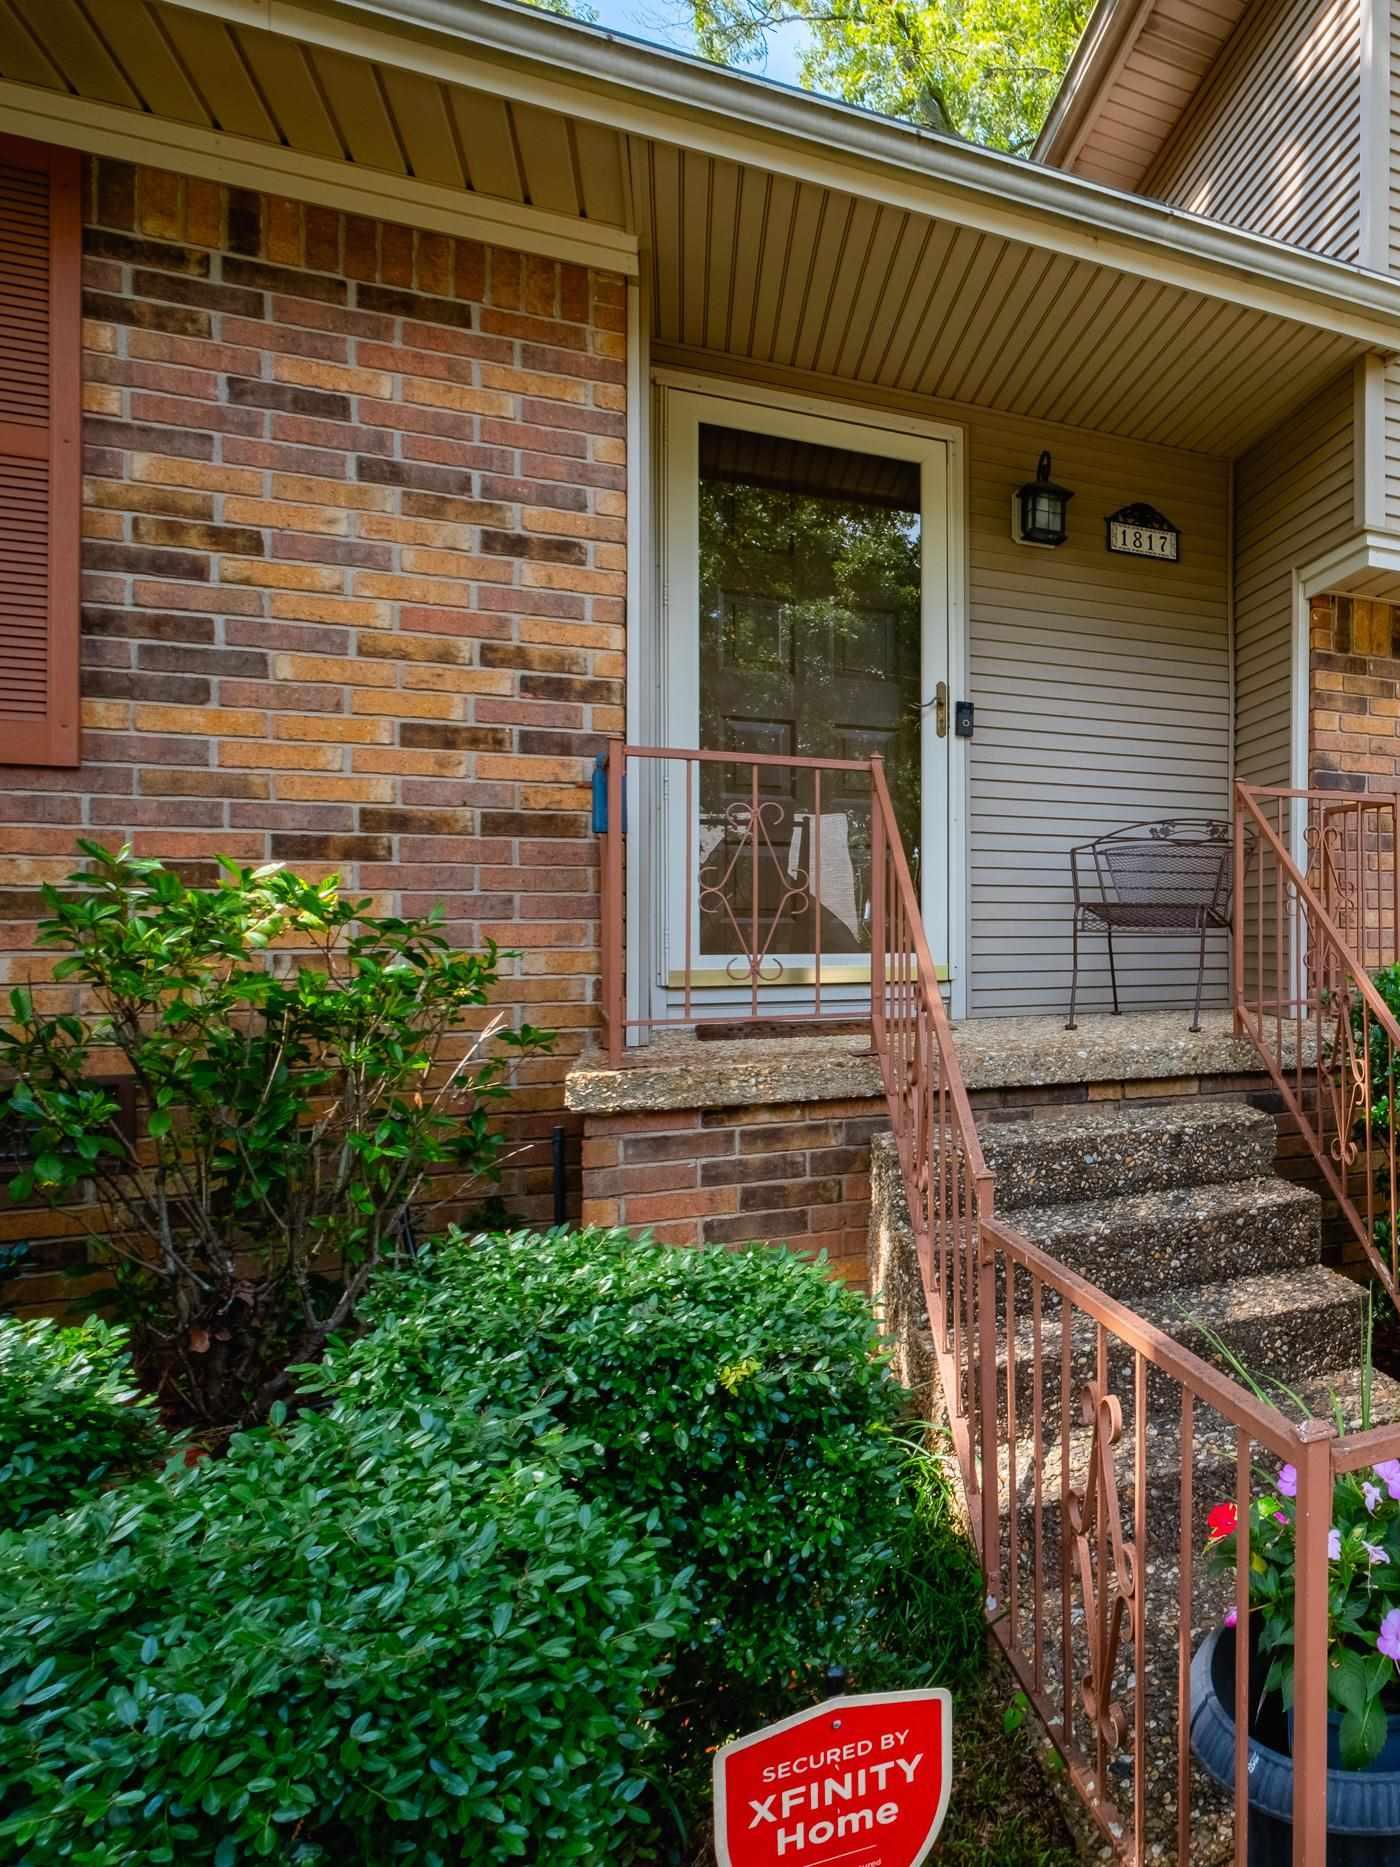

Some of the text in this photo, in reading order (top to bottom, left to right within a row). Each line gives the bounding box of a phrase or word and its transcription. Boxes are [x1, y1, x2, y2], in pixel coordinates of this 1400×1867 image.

[1121, 529, 1168, 553] 1817
[762, 1729, 910, 1783] SECURED BY
[747, 1753, 924, 1830] XFINITY
[776, 1801, 899, 1856] Home
